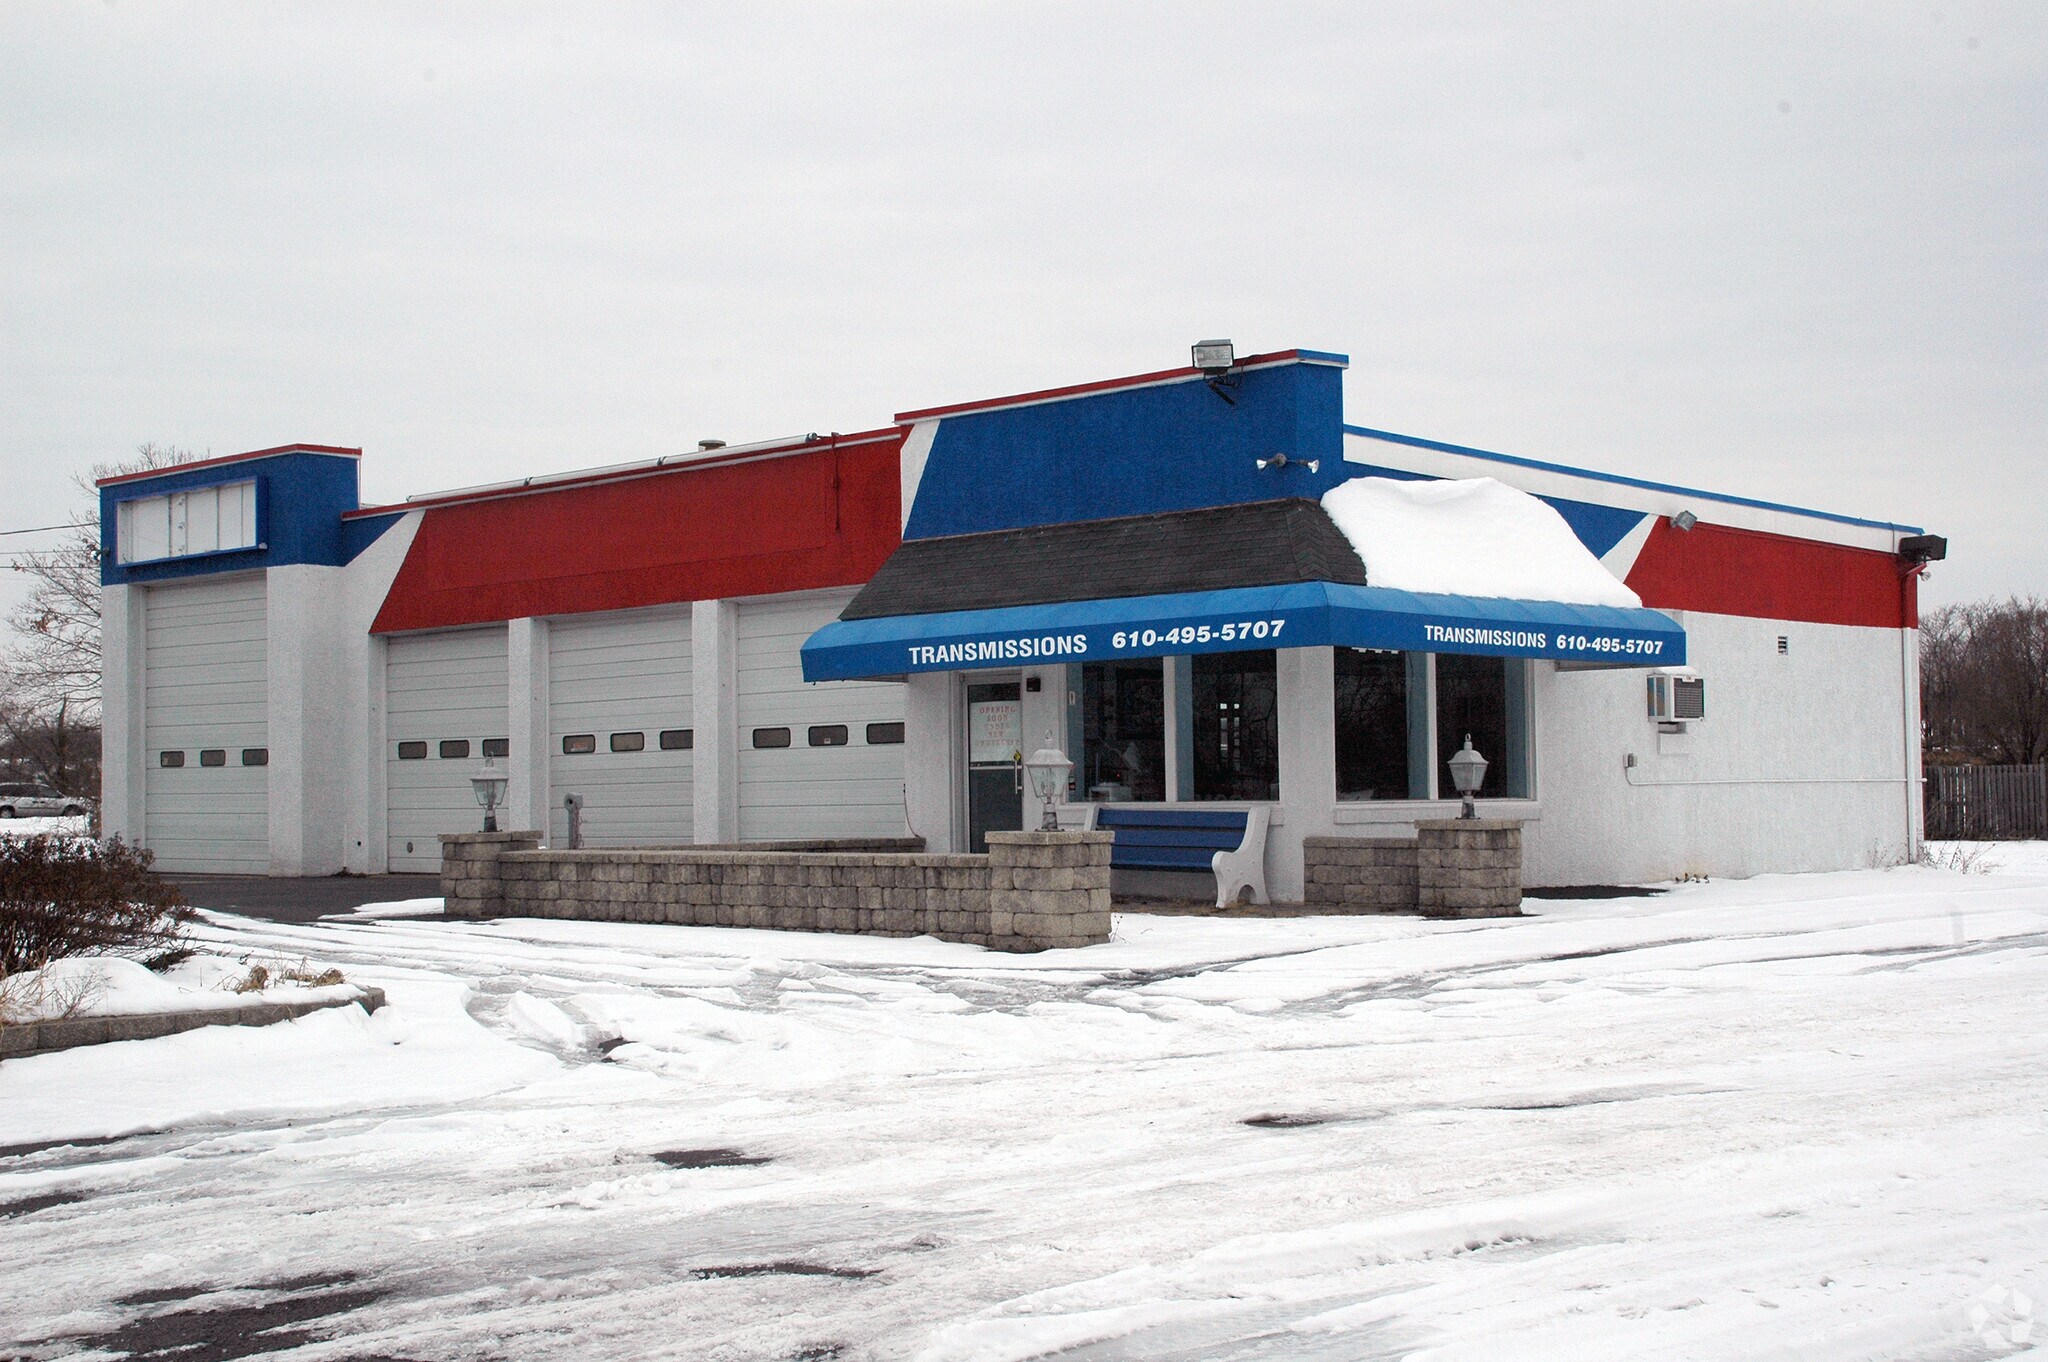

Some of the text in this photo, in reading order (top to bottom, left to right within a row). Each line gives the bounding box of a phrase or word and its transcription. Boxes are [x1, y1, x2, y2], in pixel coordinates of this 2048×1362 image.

[908, 619, 1286, 665] TRANSMISSIONS 610-495-5707
[1424, 624, 1664, 656] TRANSMISSIONS 610-495-5707
[979, 705, 1016, 713] OPENING
